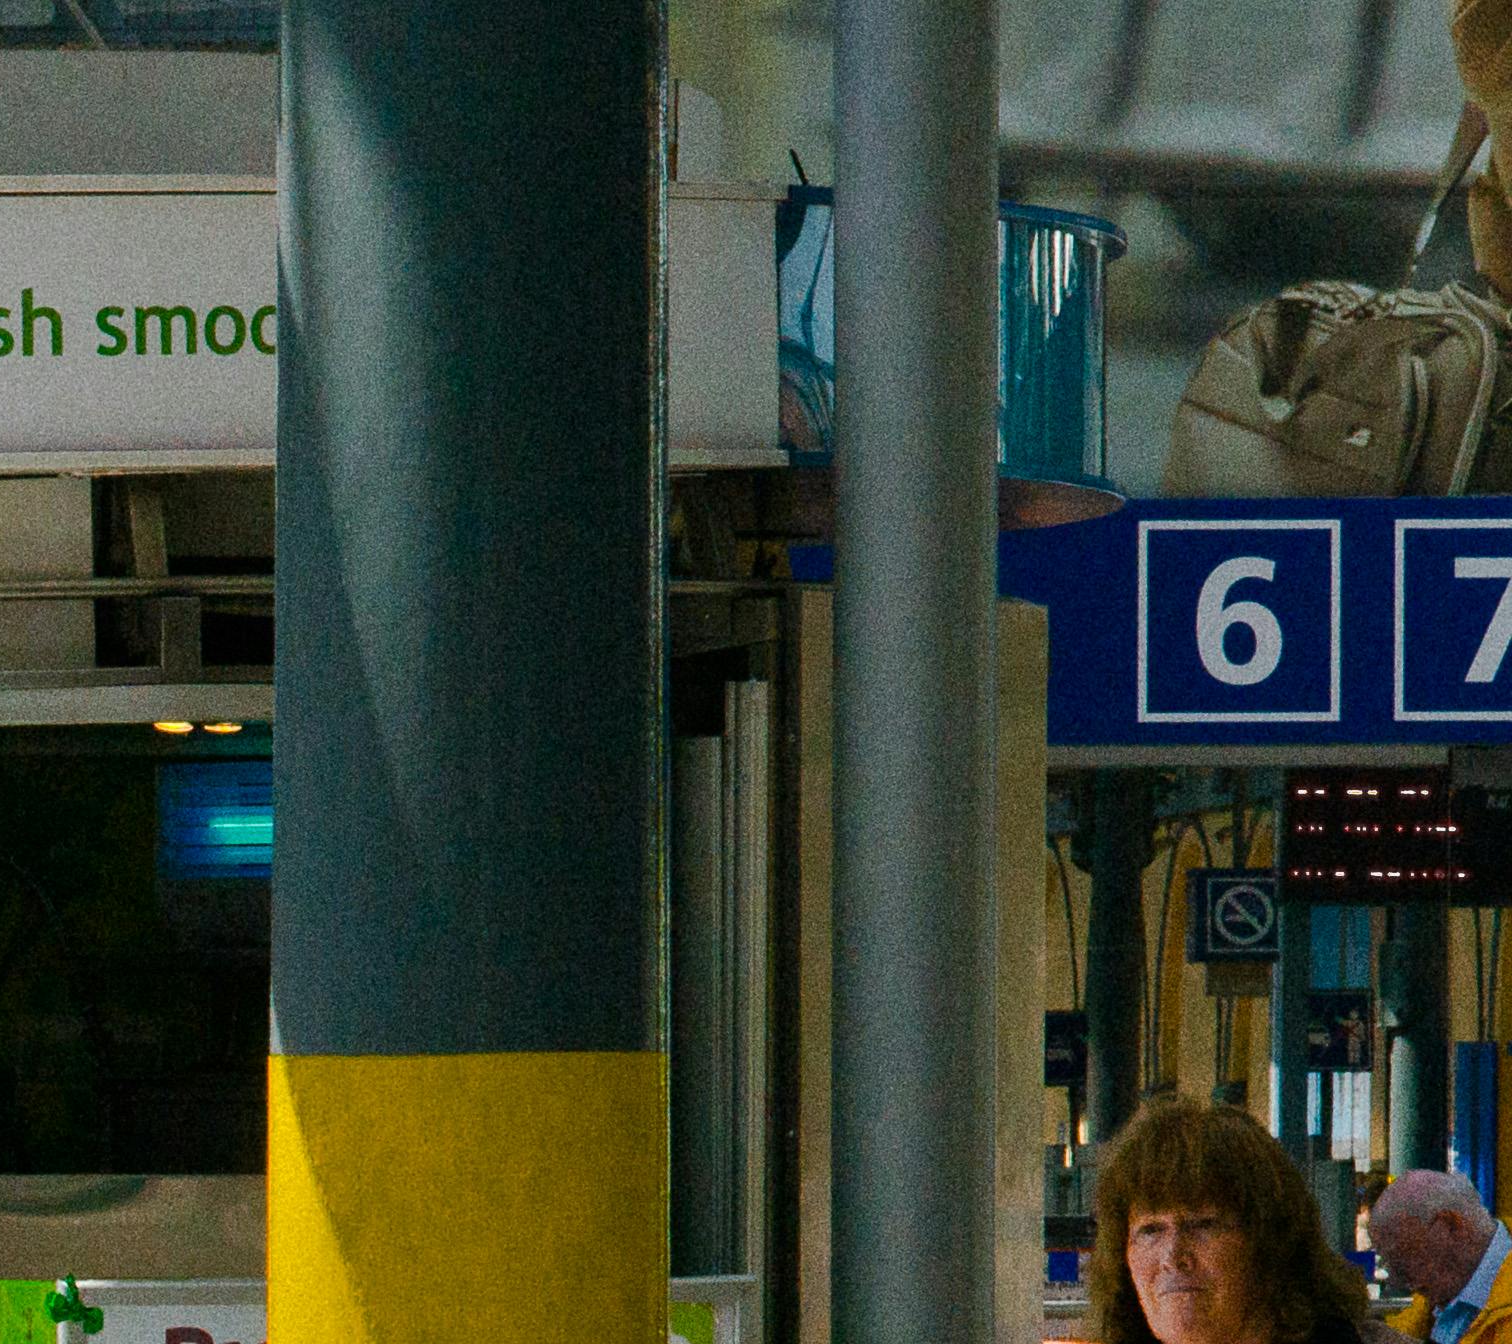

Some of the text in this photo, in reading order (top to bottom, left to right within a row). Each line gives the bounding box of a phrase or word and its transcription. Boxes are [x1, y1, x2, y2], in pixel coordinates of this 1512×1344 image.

[96, 304, 277, 357] smoo
[1195, 556, 1284, 686] 6
[1453, 556, 1512, 684] 7
